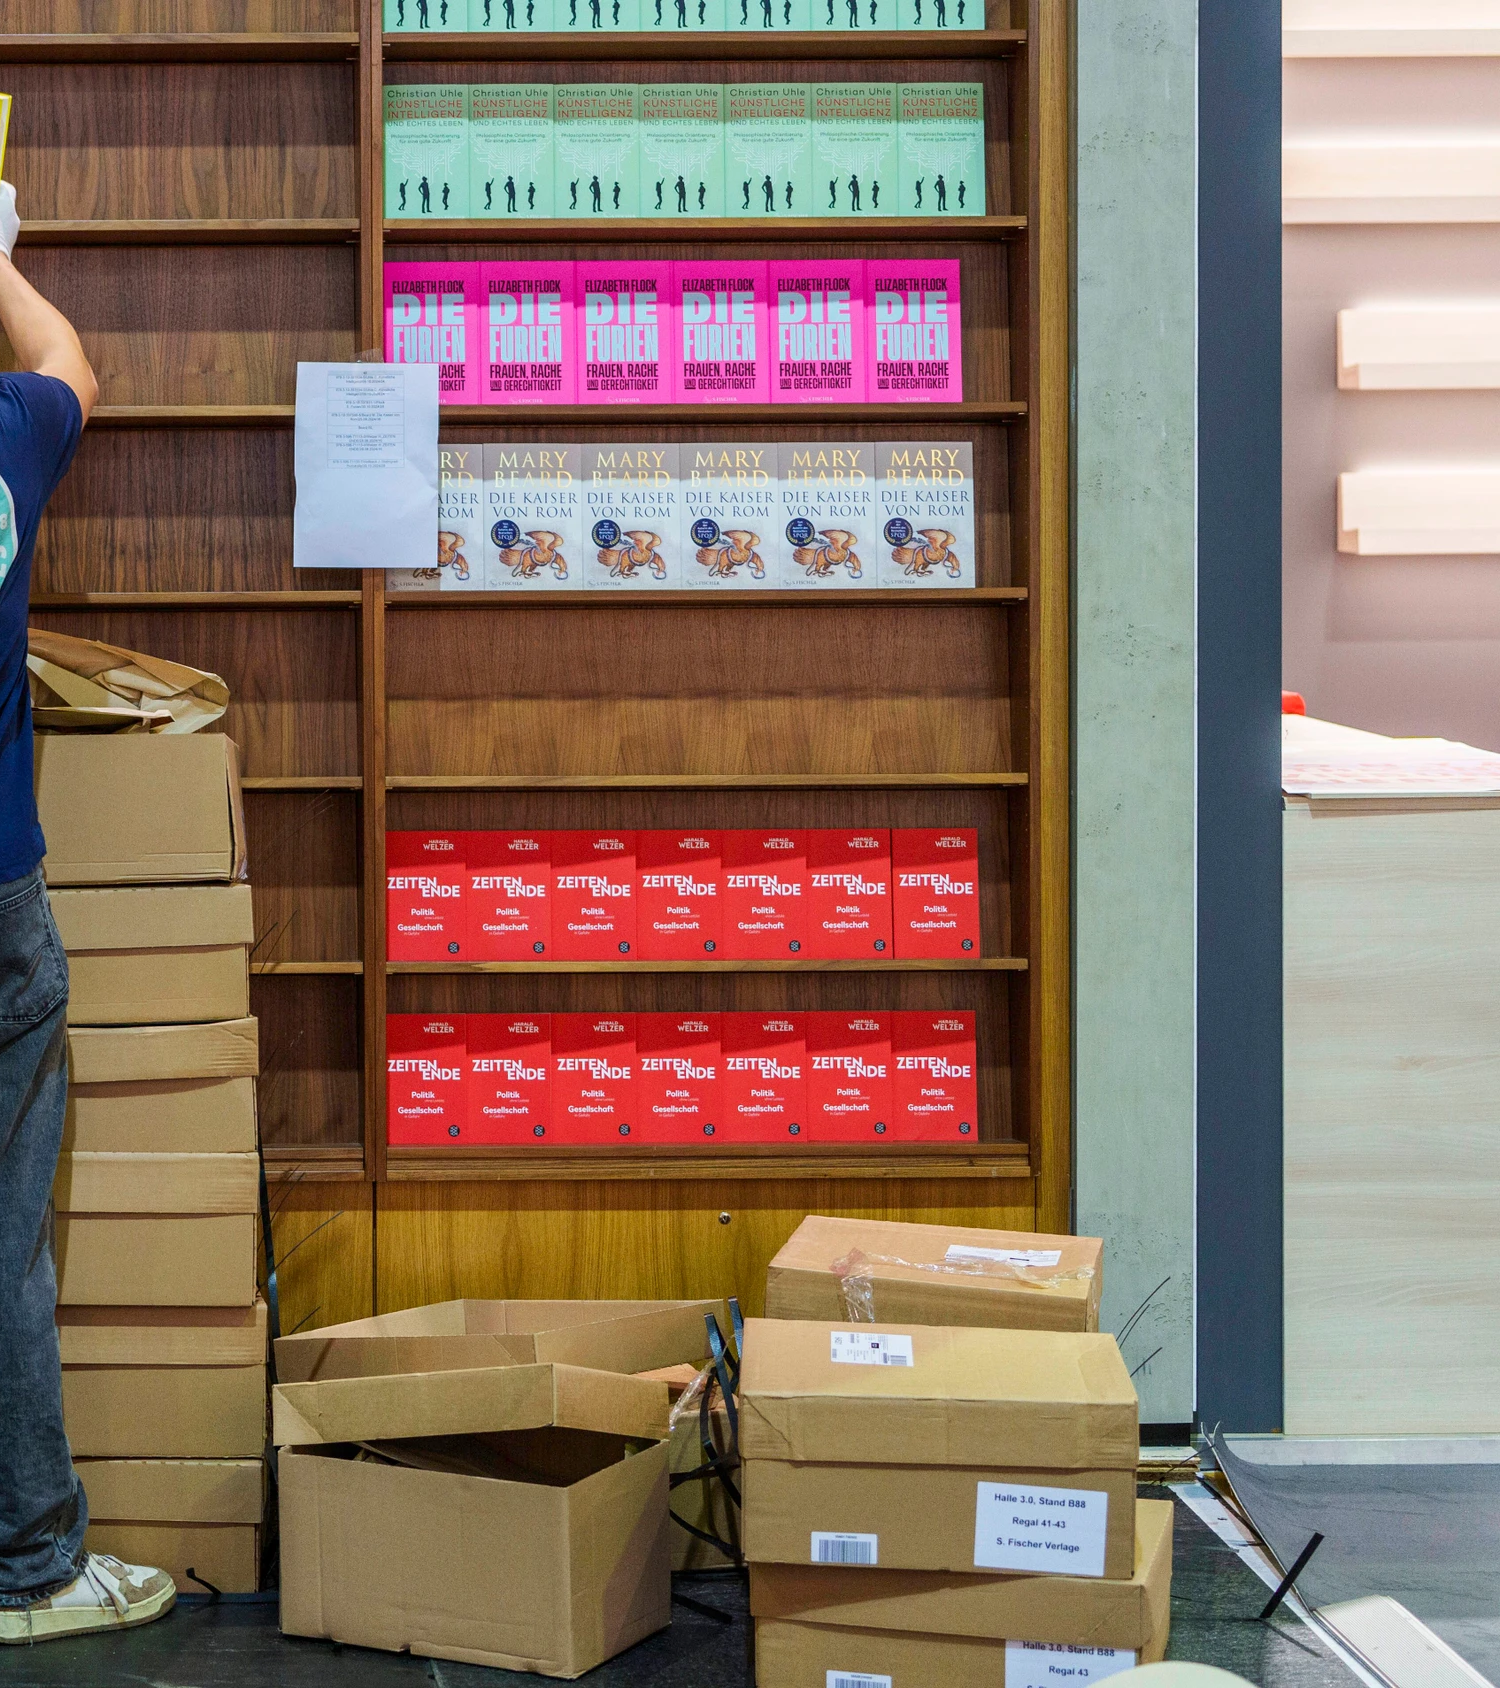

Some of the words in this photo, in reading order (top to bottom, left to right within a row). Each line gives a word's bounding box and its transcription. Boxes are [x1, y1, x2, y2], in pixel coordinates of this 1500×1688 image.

[387, 89, 436, 98] Christian
[440, 89, 463, 98] Uhle
[643, 89, 692, 97] Christian
[696, 89, 718, 97] Uhle
[902, 88, 952, 96] Christian
[955, 88, 978, 96] Uhle
[387, 99, 462, 109] KÜNSTLICHE
[643, 98, 718, 107] KÜNSTLICHE
[902, 97, 977, 106] KÜNSTLICHE
[387, 110, 462, 119] INTELLIGENZ
[643, 109, 718, 118] INTELLIGENZ
[903, 108, 977, 117] INTELLIGENZ
[489, 280, 532, 292] ELIZABETH
[535, 280, 561, 292] FLOCK
[875, 278, 920, 291] ELIZABETH
[921, 278, 947, 291] FLOCK
[489, 293, 561, 324] DIE
[875, 292, 948, 323] DIE
[489, 326, 562, 363] FURIEN
[876, 324, 948, 361] FURIEN
[490, 364, 528, 379] FRAUEN,
[531, 364, 562, 378] RACHE
[877, 362, 915, 377] FRAUEN,
[918, 362, 949, 376] RACHE
[490, 380, 502, 391] UND
[504, 380, 561, 391] GERECHTIGKEIT
[878, 378, 889, 390] UND
[891, 378, 949, 389] GERECHTIGKEIT
[499, 451, 567, 468] MARY
[695, 450, 764, 468] MARY
[891, 449, 959, 466] MARY
[494, 471, 573, 488] BEARD
[690, 470, 769, 487] BEARD
[886, 469, 964, 486] BEARD
[489, 492, 515, 504] DIE
[524, 492, 578, 504] KAISER
[686, 492, 712, 503] DIE
[720, 492, 775, 503] KAISER
[881, 491, 907, 502] DIE
[916, 491, 970, 502] KAISER
[493, 506, 528, 518] VON
[536, 506, 573, 518] ROM
[689, 506, 724, 517] VON
[732, 506, 769, 517] ROM
[885, 505, 920, 516] VON
[928, 505, 965, 516] ROM
[472, 877, 522, 889] ZEITEN
[899, 874, 949, 886] ZEITEN
[507, 885, 545, 897] ENDE
[934, 882, 973, 894] ENDE
[641, 1059, 691, 1070] ZEITEN
[677, 1067, 715, 1079] ENDE
[994, 1493, 1017, 1502] Halle
[1020, 1496, 1036, 1504] 3.0,
[1039, 1497, 1065, 1506] Stand
[1069, 1500, 1086, 1508] B88
[1012, 1517, 1038, 1527] Regal
[1041, 1520, 1066, 1528] 41-43
[997, 1537, 1005, 1545] S.
[1008, 1538, 1042, 1548] Fischer
[1045, 1542, 1080, 1553] Verlage
[1023, 1641, 1045, 1650] Halle
[1049, 1643, 1064, 1654] 3.0,
[1067, 1645, 1094, 1655] Stand
[1097, 1648, 1115, 1657] B88
[1049, 1665, 1075, 1676] Regal
[1078, 1667, 1088, 1677] 43
